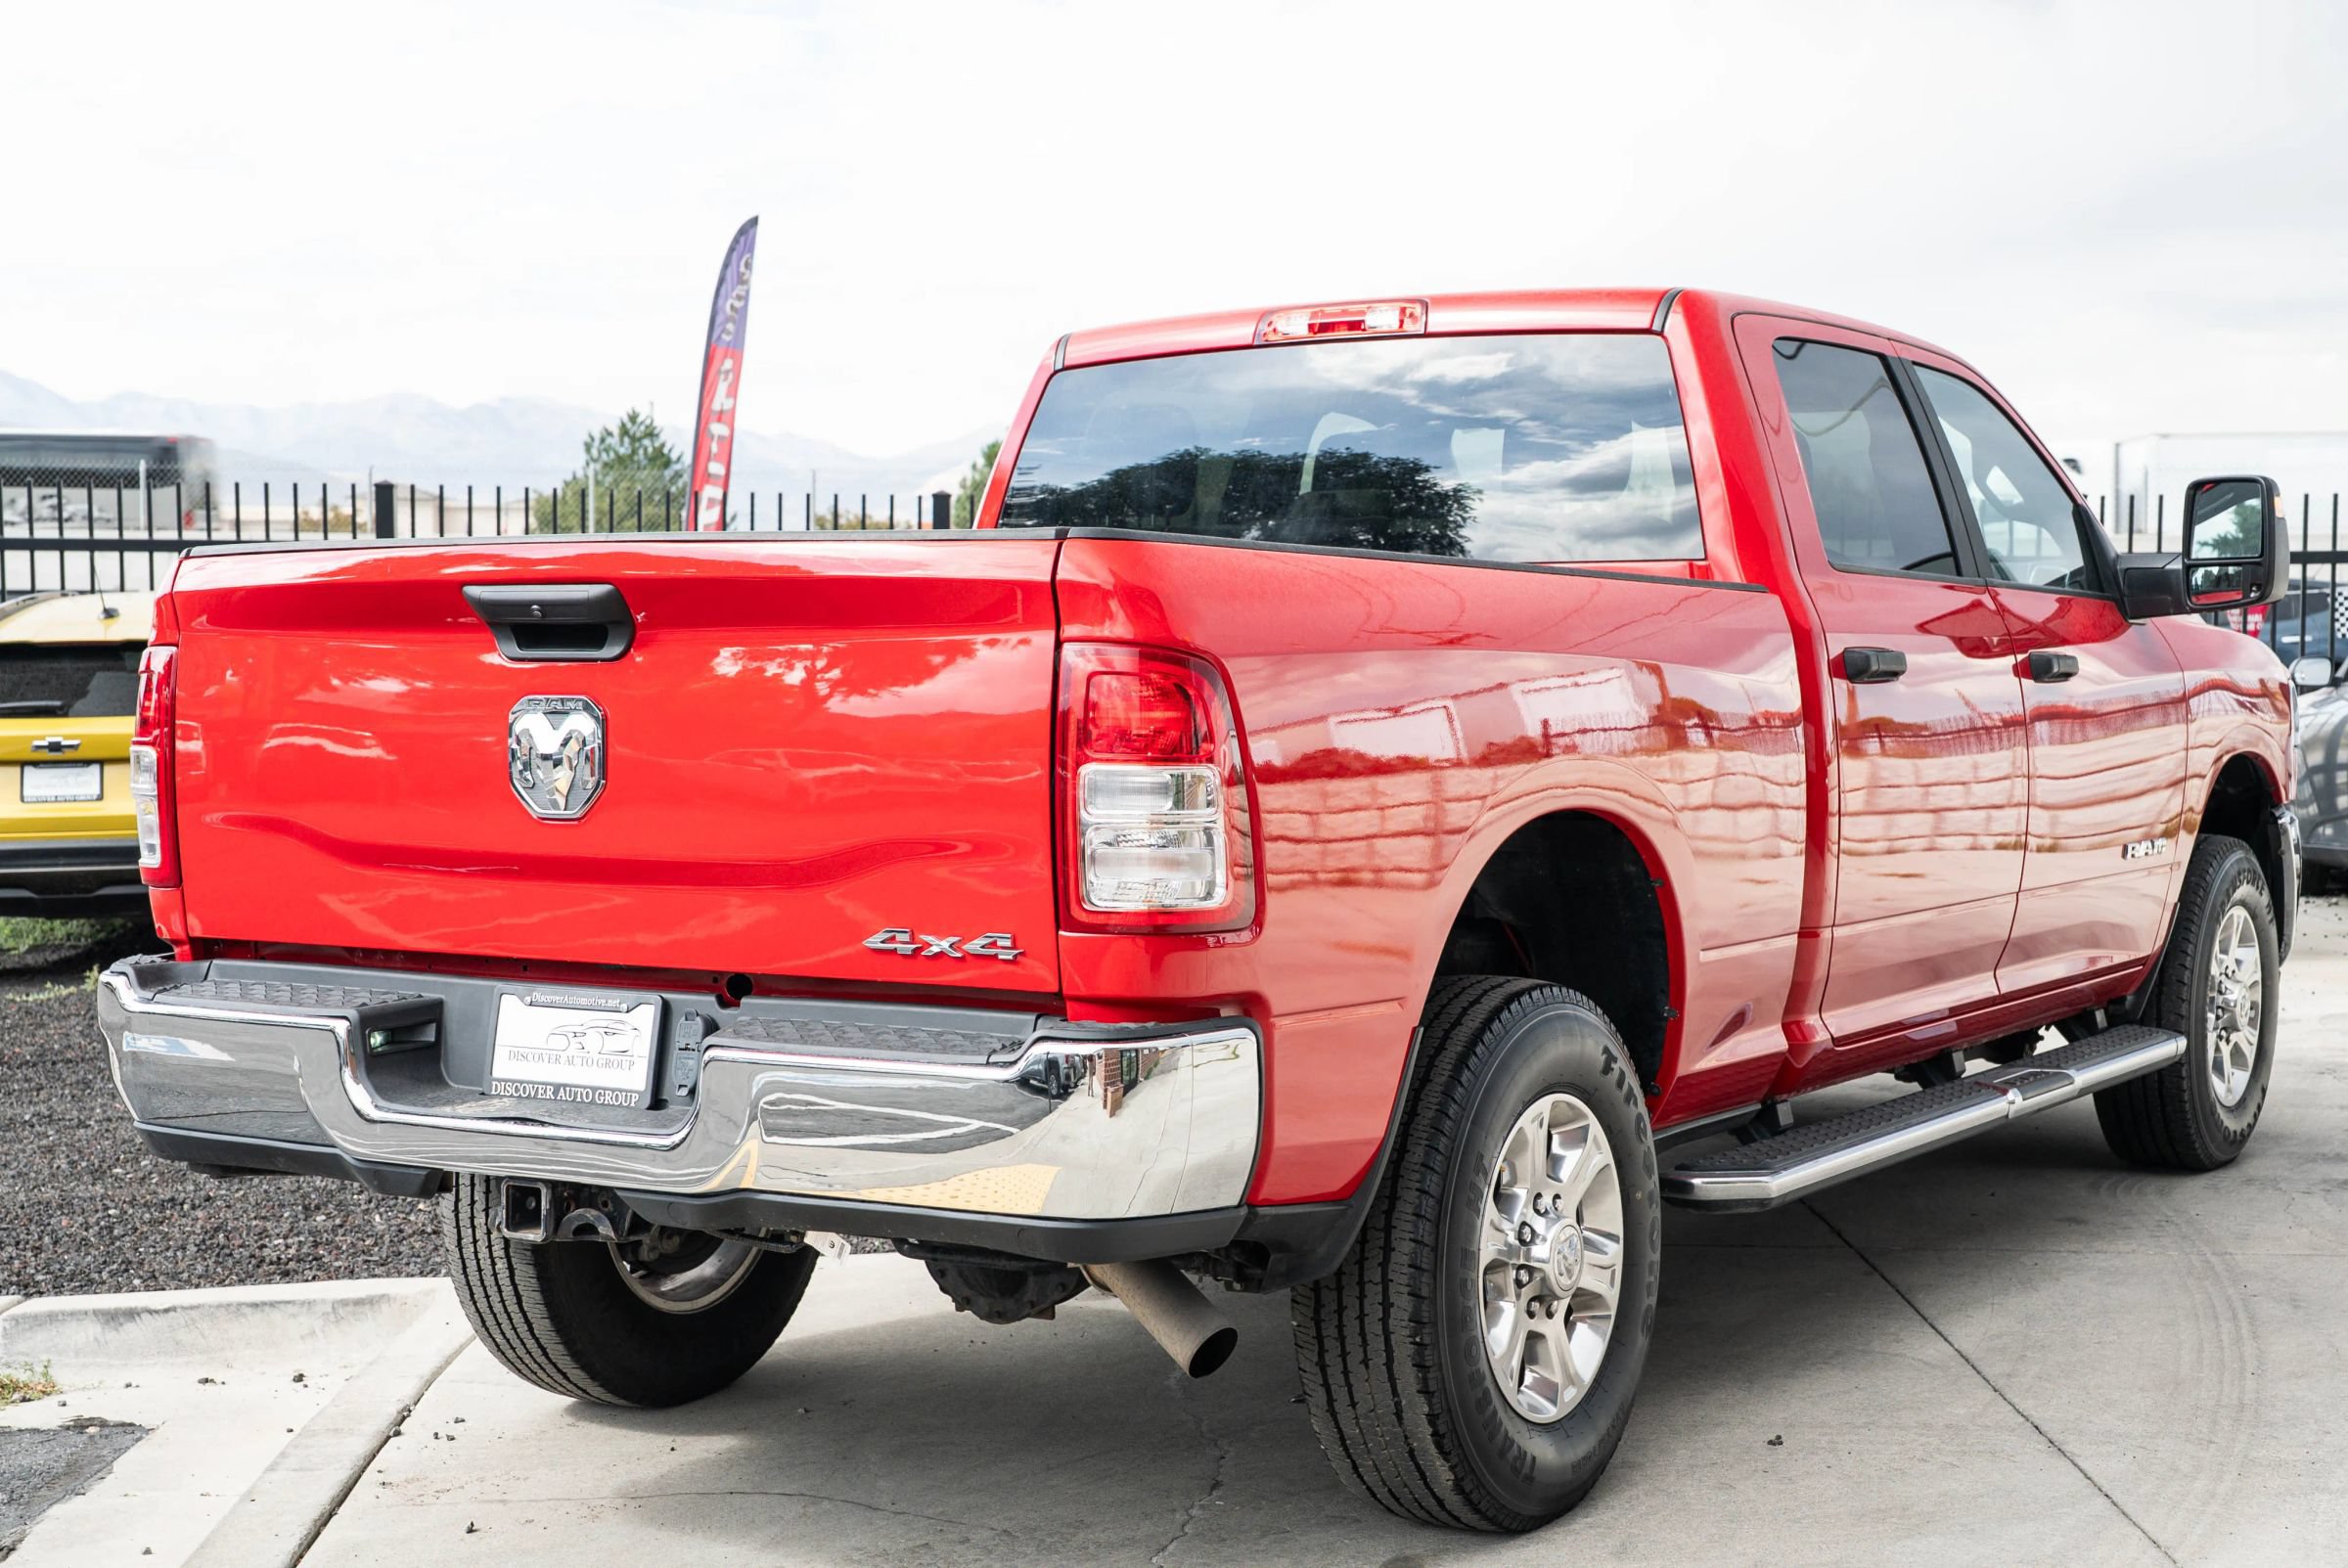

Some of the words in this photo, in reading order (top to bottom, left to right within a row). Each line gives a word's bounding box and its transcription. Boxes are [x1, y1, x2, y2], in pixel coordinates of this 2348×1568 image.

[526, 698, 584, 710] RAM
[2121, 836, 2168, 861] RAM
[861, 927, 1025, 961] 4x4
[531, 992, 621, 1008] DiscoverAutomotive.net
[508, 1050, 563, 1066] DISCOVER
[564, 1055, 594, 1068] AUTO
[596, 1059, 635, 1072] GROUP
[491, 1081, 555, 1100] DISCOVER
[557, 1087, 593, 1103] AUTO
[595, 1090, 639, 1107] GROUP
[1465, 1150, 1493, 1220] HT
[1458, 1244, 1536, 1486] TRANSFORCE
